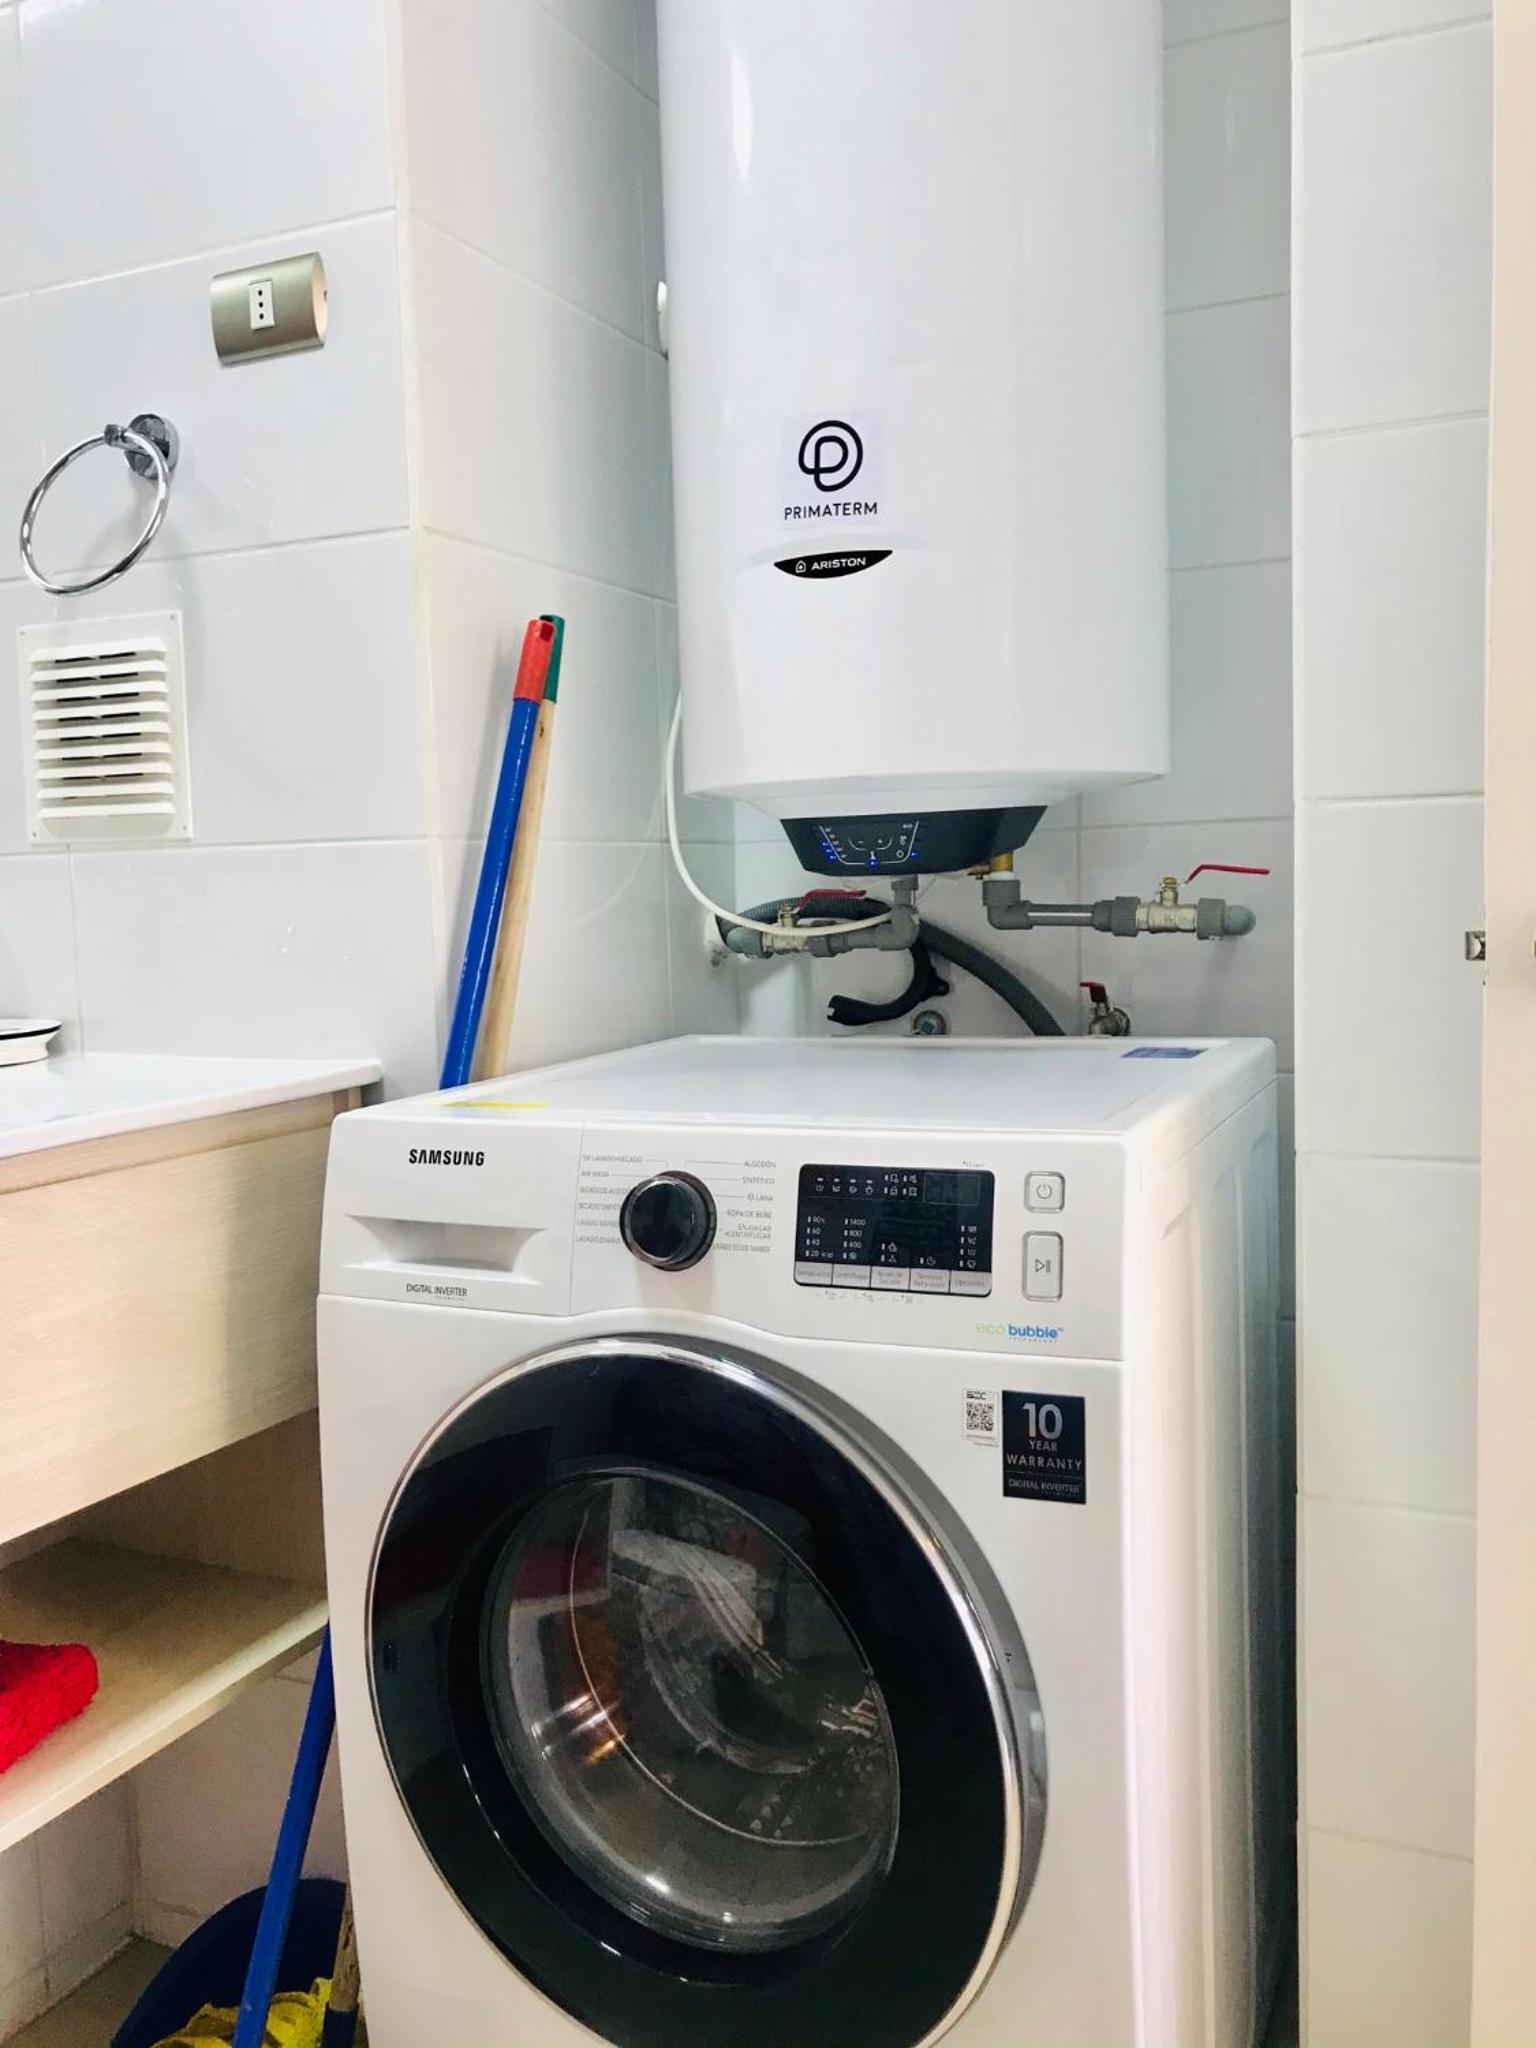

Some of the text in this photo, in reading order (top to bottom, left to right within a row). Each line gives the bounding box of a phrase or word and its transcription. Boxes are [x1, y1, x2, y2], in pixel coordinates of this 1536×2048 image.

[784, 502, 878, 520] PRIMATERM
[811, 557, 867, 571] ARISTON
[409, 1149, 485, 1166] SAMSUNG
[407, 1283, 432, 1294] DIGITAL
[976, 1322, 1005, 1334] eco
[1023, 1402, 1063, 1440] 10
[1029, 1439, 1058, 1452] YEAR
[1006, 1453, 1082, 1471] WARRANTY
[1008, 1478, 1040, 1490] DIGITAL
